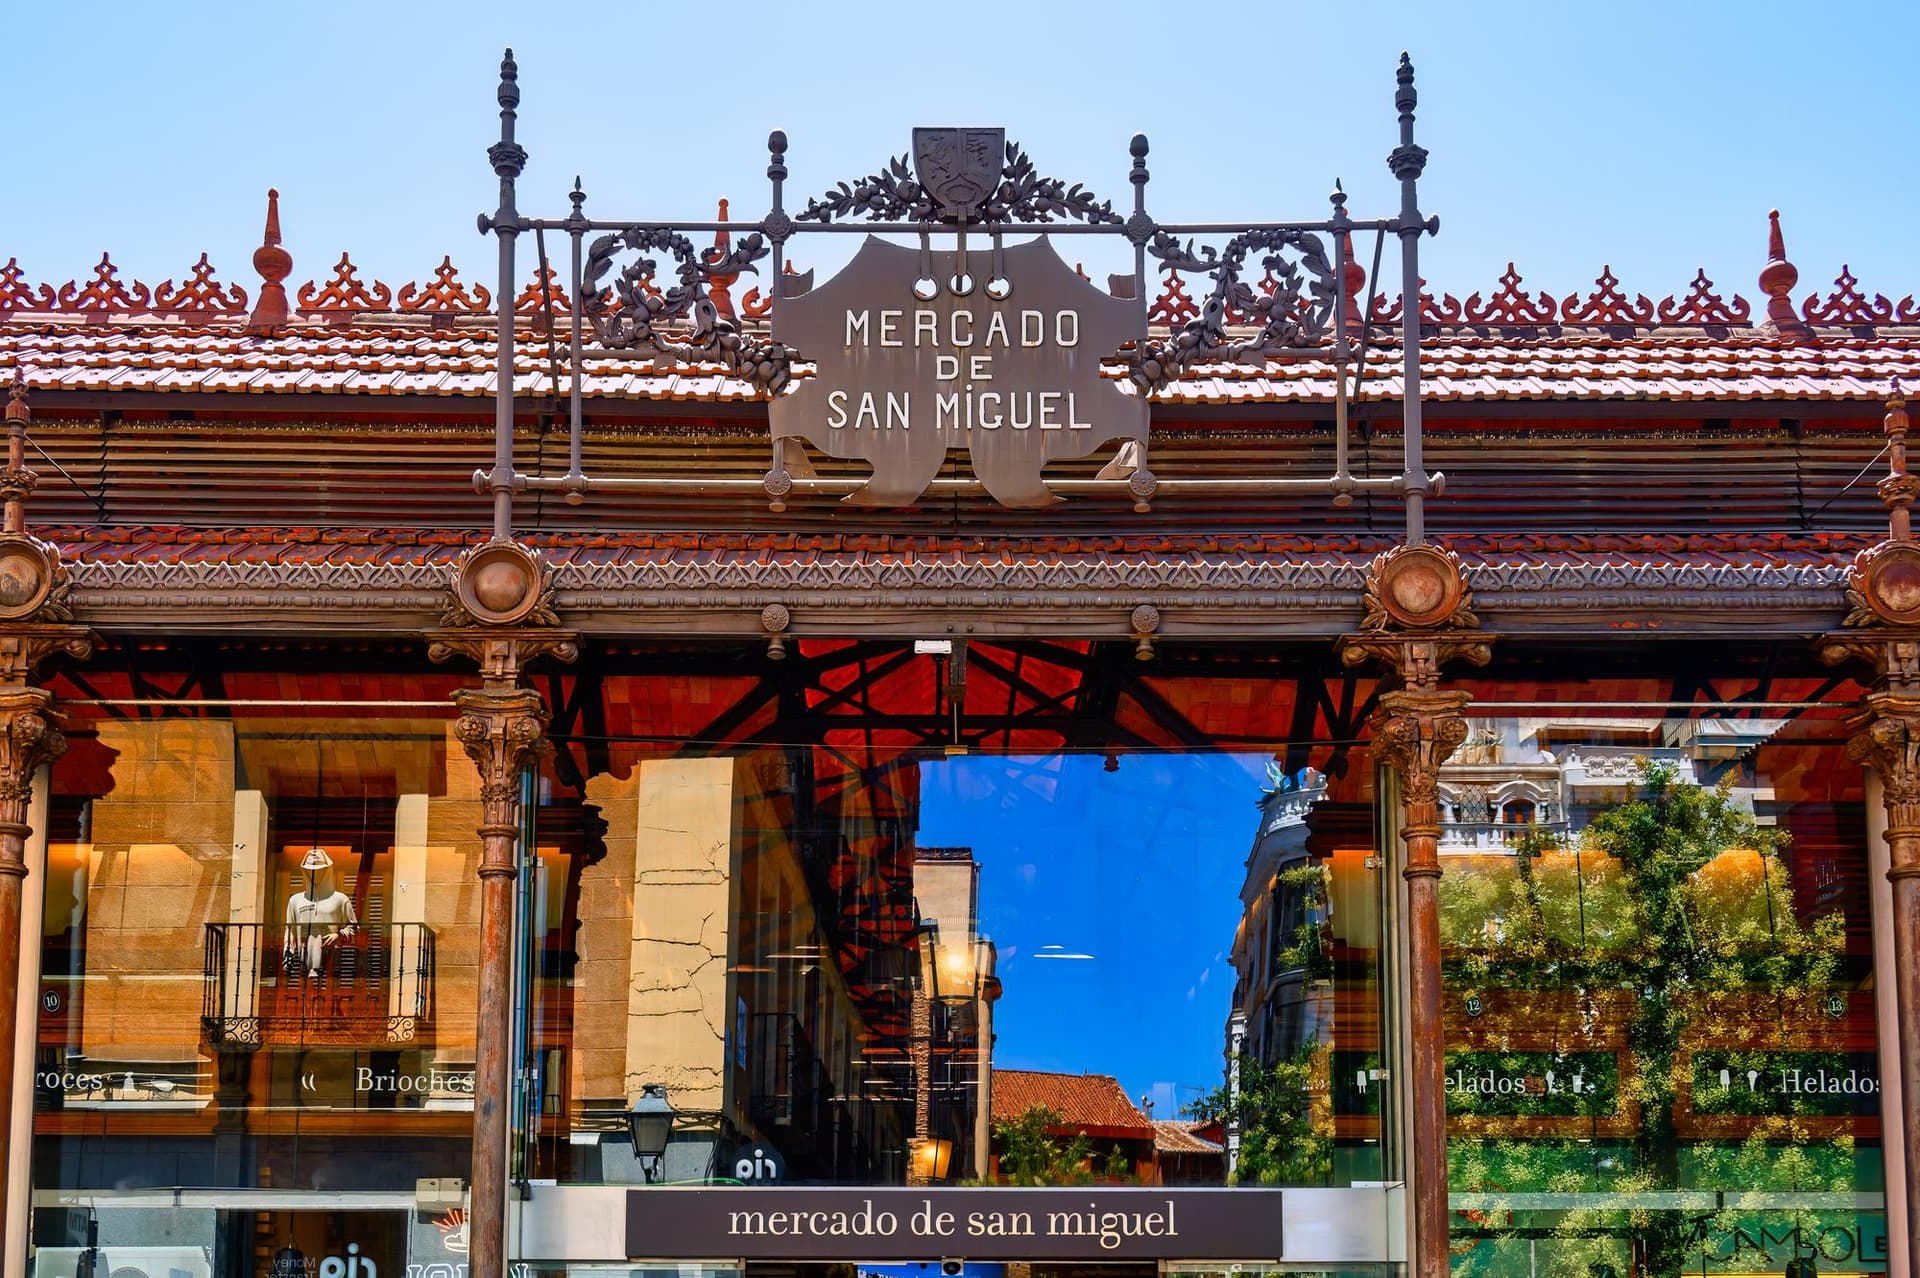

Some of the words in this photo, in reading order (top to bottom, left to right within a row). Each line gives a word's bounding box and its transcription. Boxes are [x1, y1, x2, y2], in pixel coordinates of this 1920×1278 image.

[845, 309, 1080, 348] MERCADO
[936, 355, 993, 381] DE
[827, 390, 910, 430] SAN
[45, 995, 58, 1008] 10
[1468, 999, 1480, 1011] 12
[355, 1067, 475, 1092] Brioches
[727, 1201, 898, 1236] mercado
[911, 1201, 955, 1236] de
[968, 1210, 1035, 1236] san
[1046, 1201, 1178, 1248] miguel
